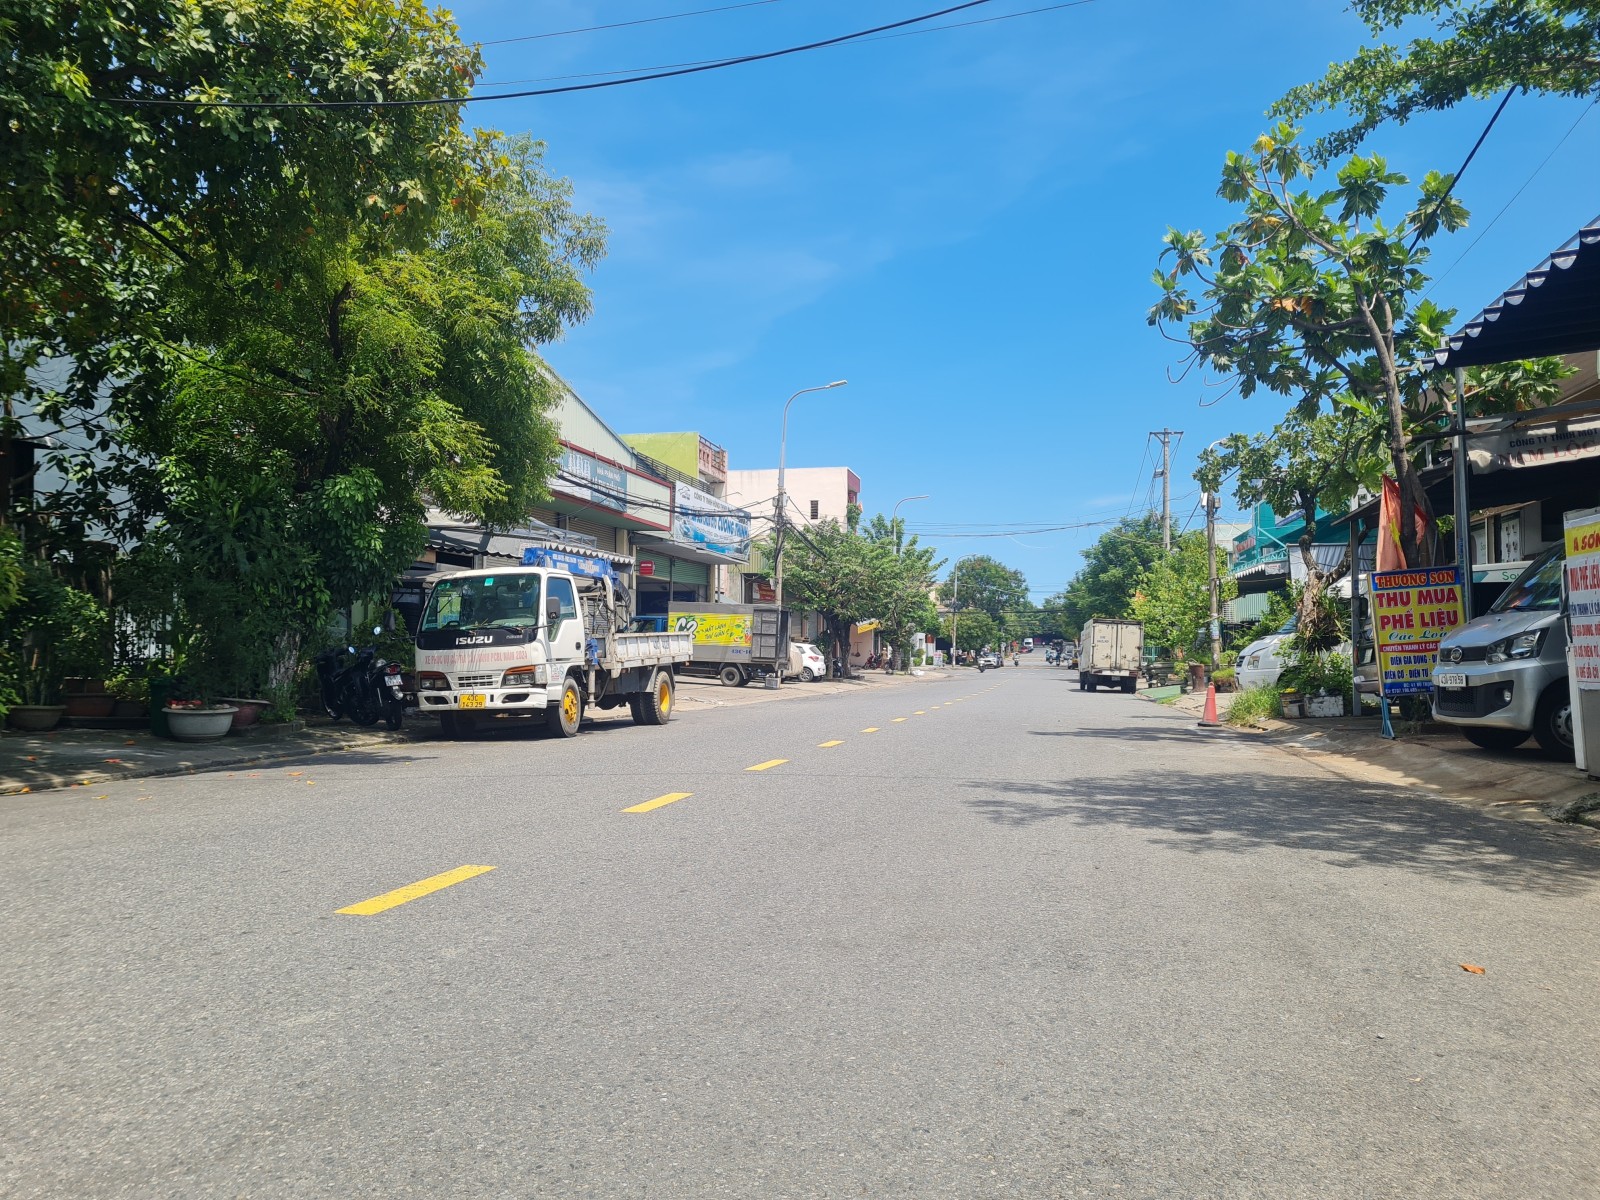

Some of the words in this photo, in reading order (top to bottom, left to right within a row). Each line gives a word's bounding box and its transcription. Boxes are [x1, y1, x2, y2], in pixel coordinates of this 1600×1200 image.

[1376, 590, 1412, 608] THU
[1416, 587, 1459, 605] MUA
[1379, 608, 1415, 631] PHẾ
[1420, 608, 1458, 630] LIỆU
[455, 635, 493, 645] ISUZU
